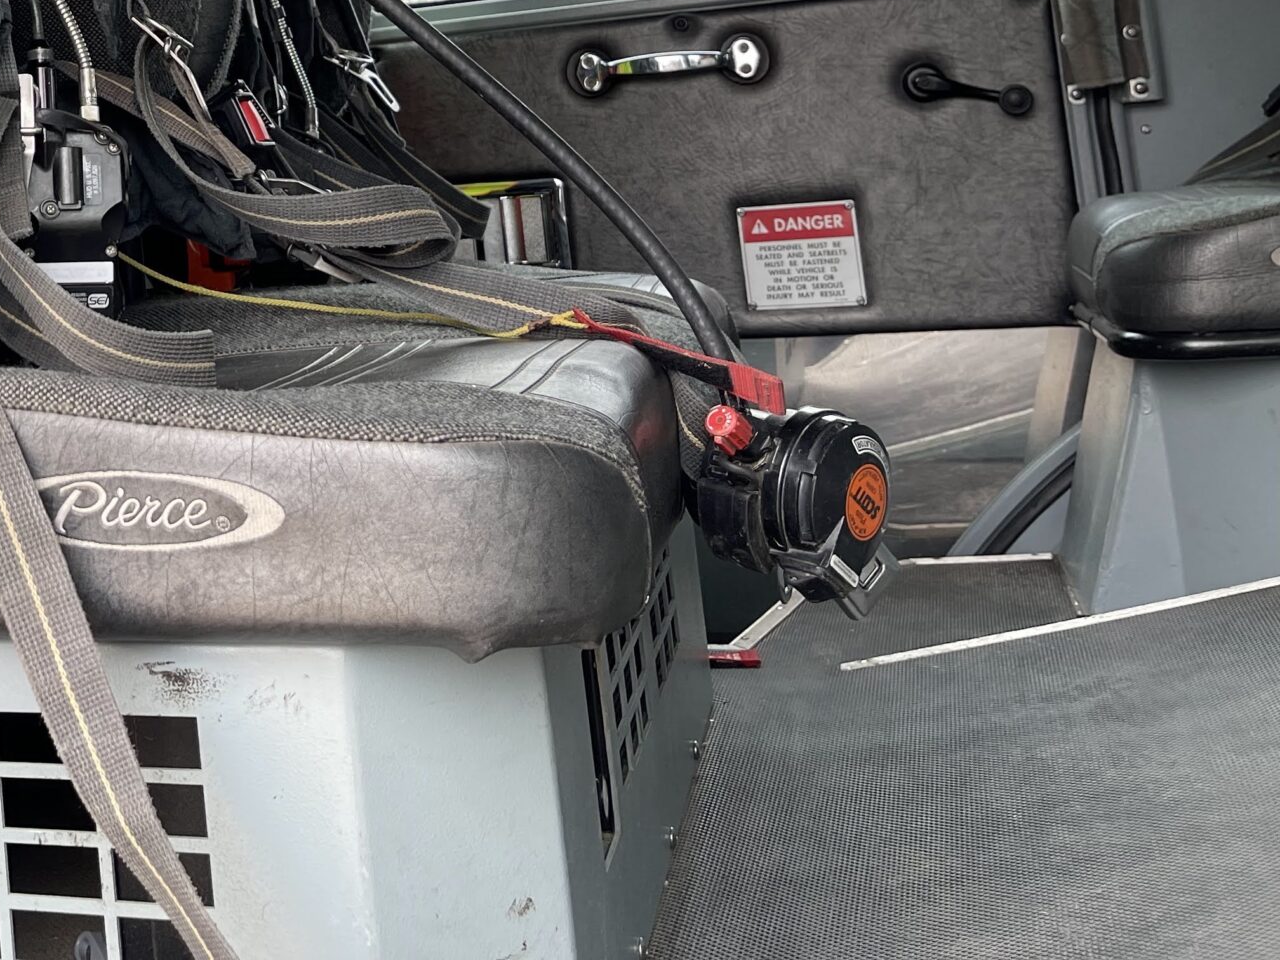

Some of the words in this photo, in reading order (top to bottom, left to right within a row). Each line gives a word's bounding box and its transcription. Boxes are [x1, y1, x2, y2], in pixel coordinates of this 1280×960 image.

[773, 214, 844, 232] DANGER
[759, 243, 803, 252] PERSONNEL
[807, 241, 828, 249] MUST
[755, 252, 782, 261] SEATED
[787, 251, 804, 259] AND
[809, 249, 847, 257] SEATBELTS
[764, 260, 784, 268] MUST
[789, 259, 797, 267] BE
[802, 258, 840, 266] FASTENED
[768, 268, 791, 276] WHILE
[796, 266, 825, 275] VEHICLE
[787, 275, 819, 283] MOTION
[767, 284, 791, 293] DEATH
[796, 283, 807, 291] OR
[812, 282, 844, 290] SERIOUS
[766, 292, 793, 300] INJURY
[798, 291, 815, 299] MAY
[820, 289, 845, 297] RESULT
[851, 486, 880, 520] SCOTT
